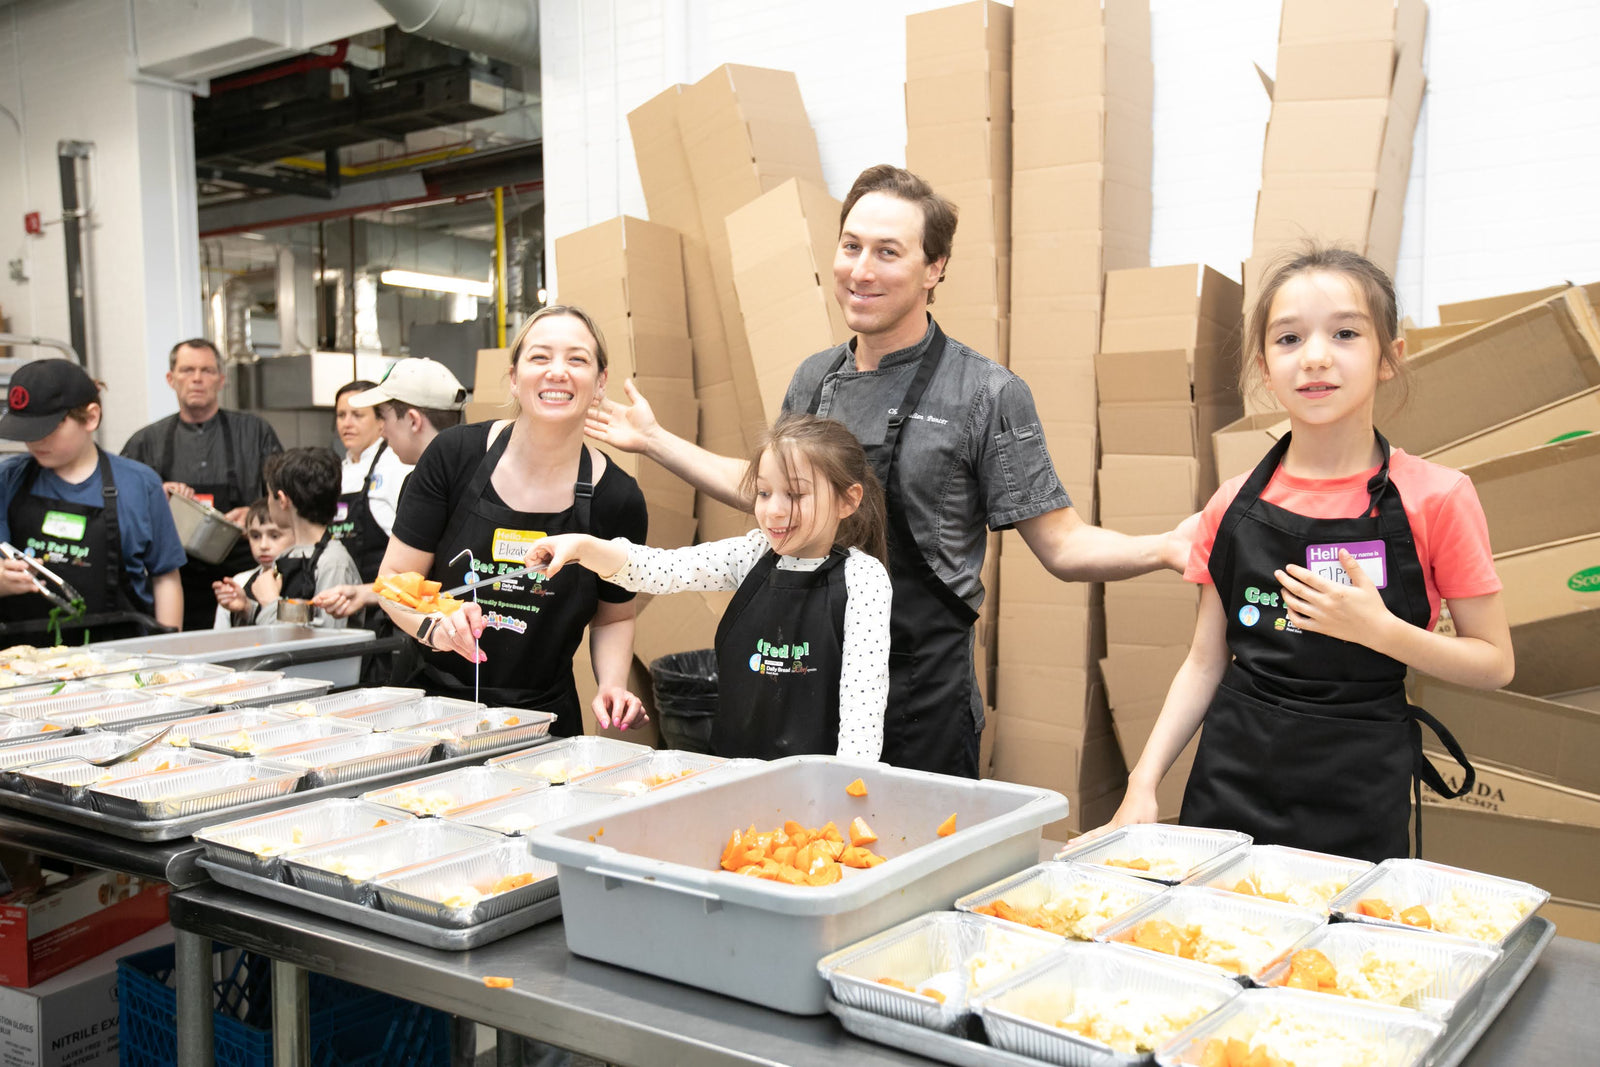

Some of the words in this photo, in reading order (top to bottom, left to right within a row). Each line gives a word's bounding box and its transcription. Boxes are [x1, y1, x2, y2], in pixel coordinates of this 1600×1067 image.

[498, 542, 529, 557] Elizab
[1310, 547, 1338, 561] Hell
[470, 558, 495, 575] Get
[1244, 586, 1280, 608] Get
[474, 598, 498, 608] roudly
[498, 600, 531, 612] Sponsored
[531, 605, 540, 614] By
[762, 642, 789, 659] Fed
[791, 641, 810, 660] p!
[51, 1023, 98, 1051] NITRILE
